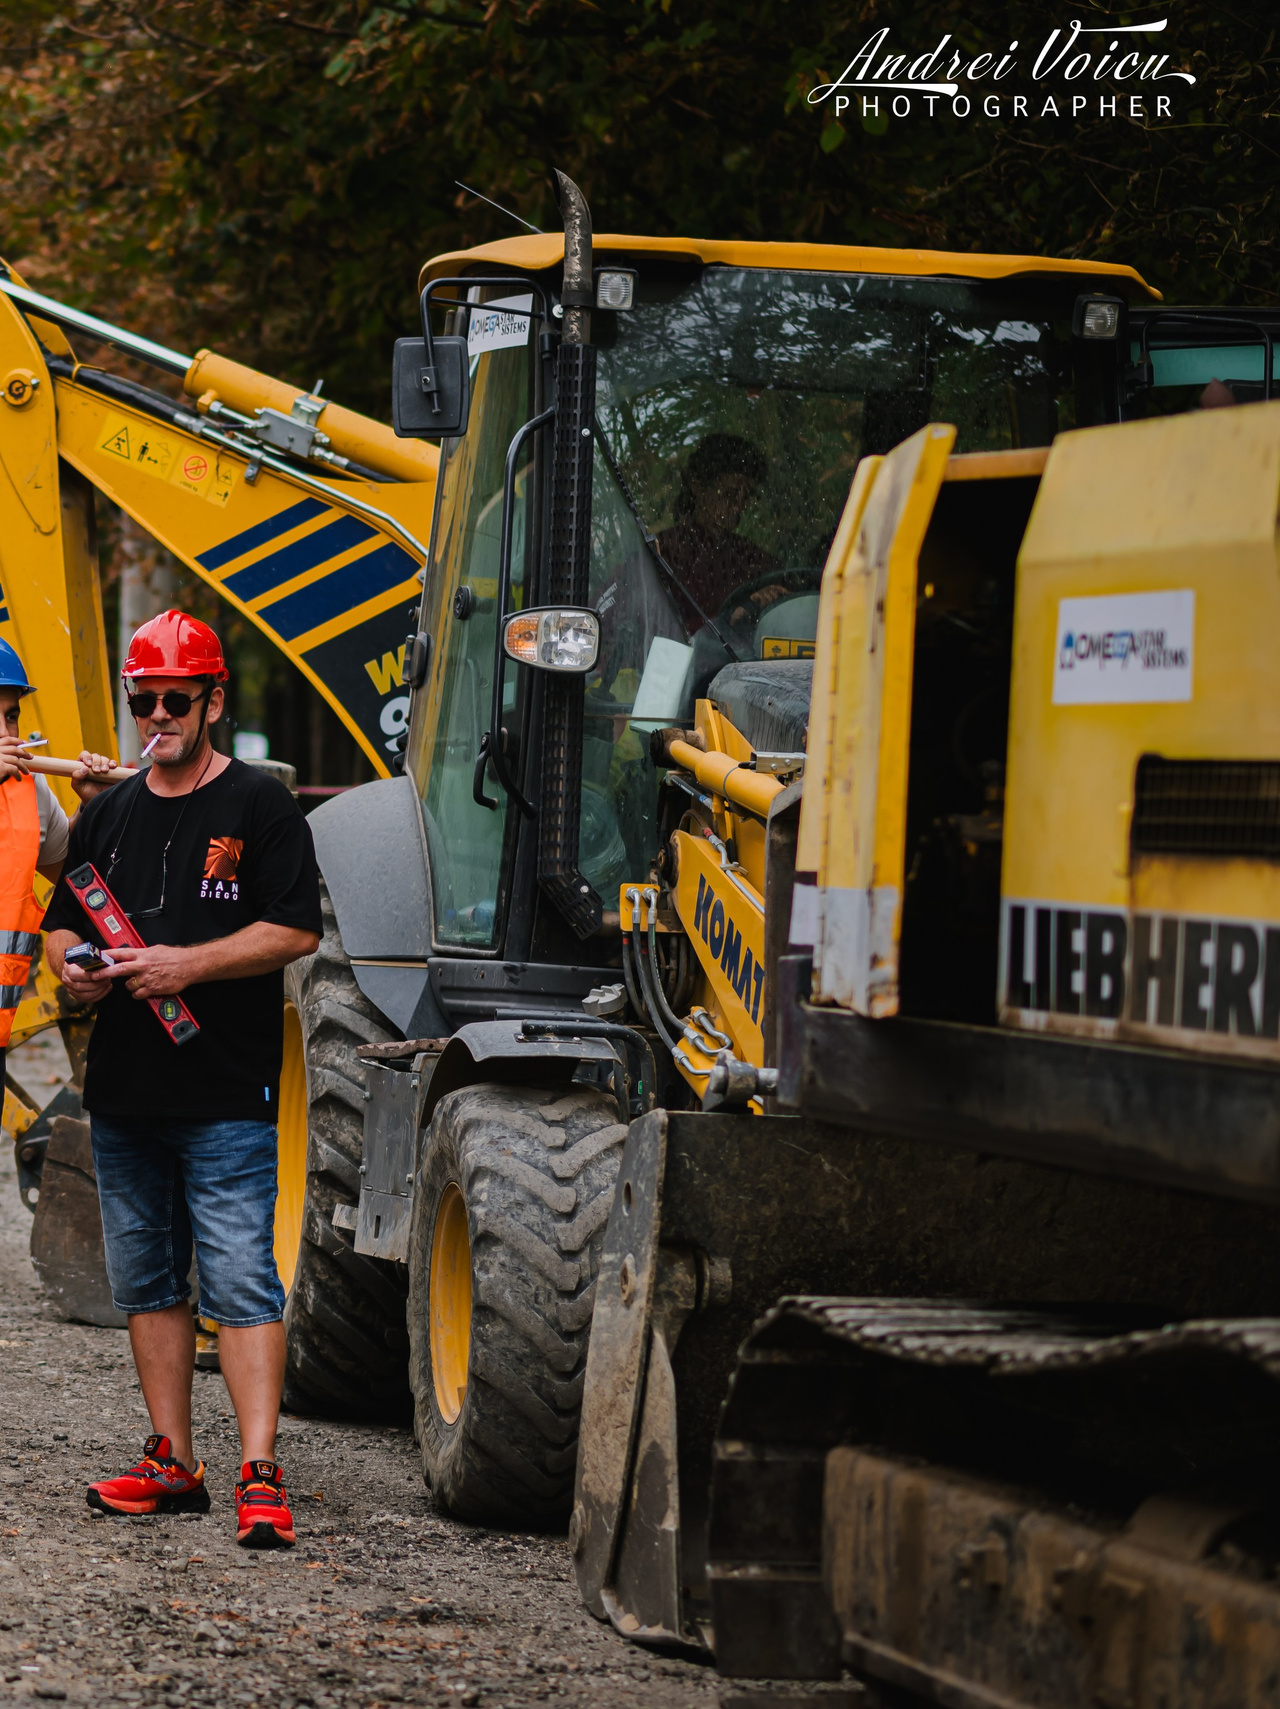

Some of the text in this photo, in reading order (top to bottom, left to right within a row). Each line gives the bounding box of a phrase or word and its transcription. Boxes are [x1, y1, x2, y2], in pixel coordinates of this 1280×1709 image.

[475, 314, 500, 340] OMEGA
[501, 320, 527, 336] SISTEMS
[200, 890, 238, 901] DIEGO
[201, 879, 239, 893] SAN
[693, 872, 766, 1036] KOMAT
[1005, 904, 1280, 1042] LIEBHER
